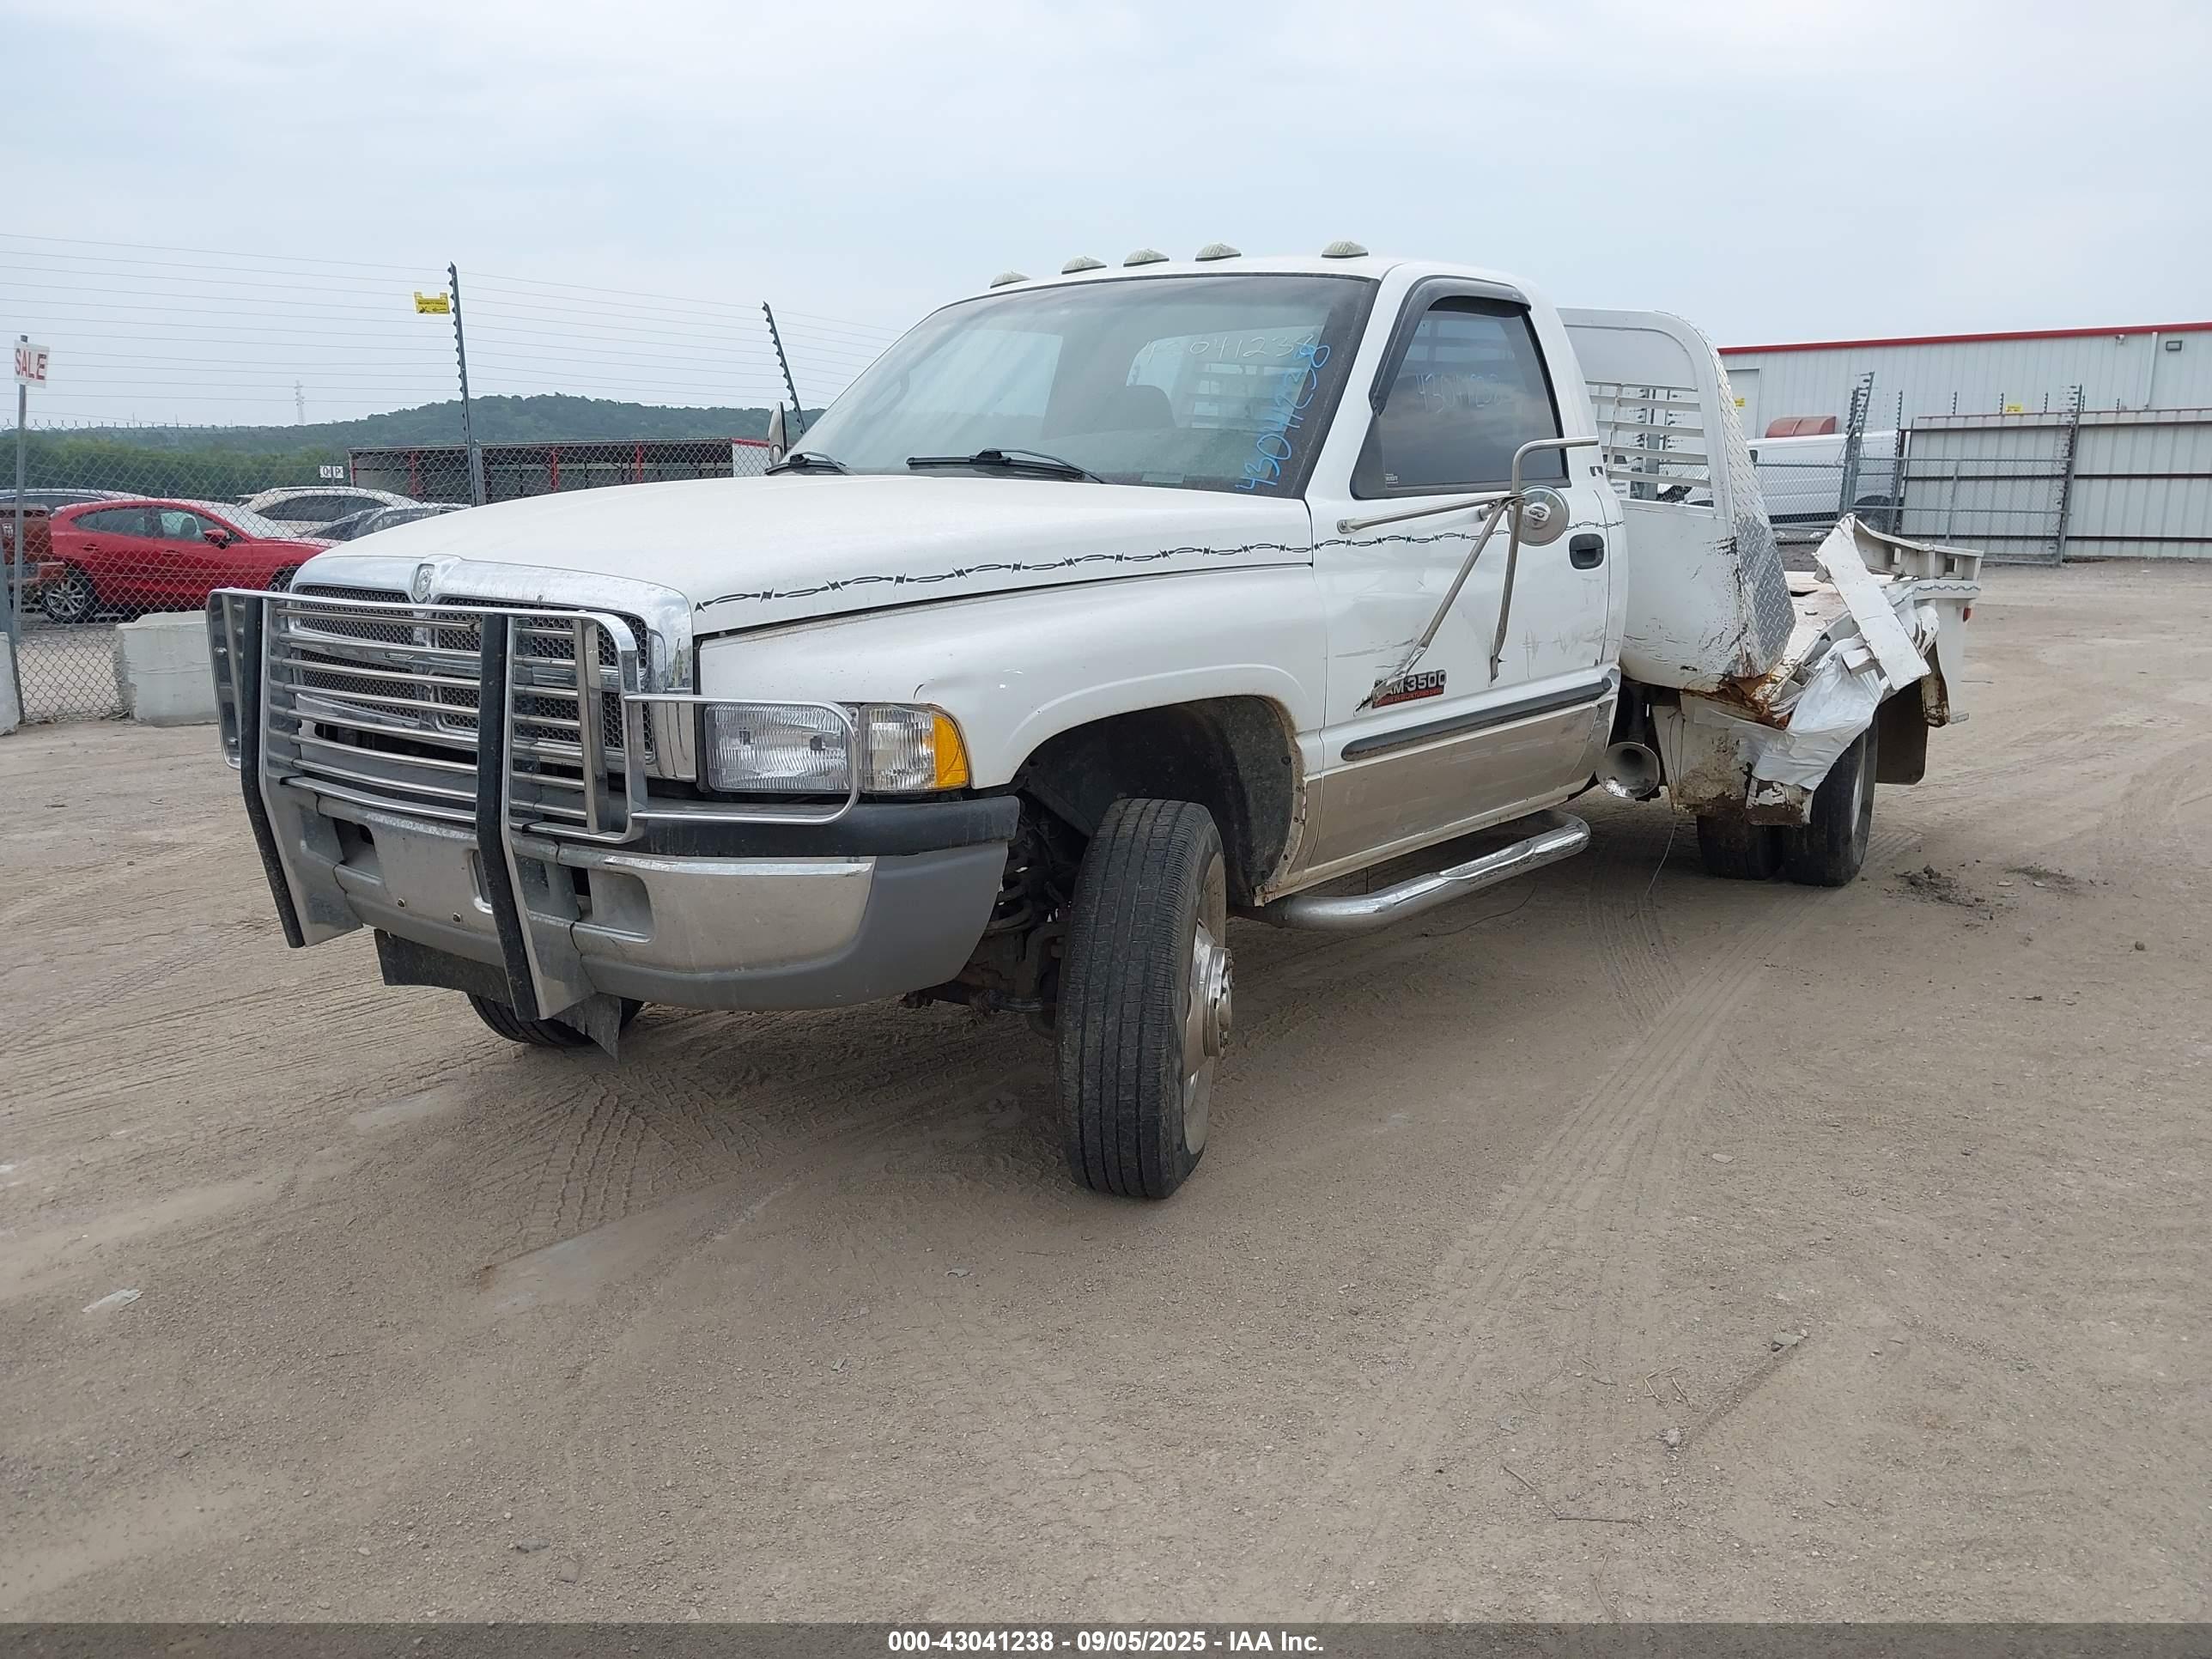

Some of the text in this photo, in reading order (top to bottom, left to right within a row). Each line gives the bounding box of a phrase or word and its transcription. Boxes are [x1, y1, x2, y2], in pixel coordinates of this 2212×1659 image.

[15, 348, 46, 380] SALE
[1235, 344, 1330, 491] 43041238
[1407, 671, 1447, 691] 3500
